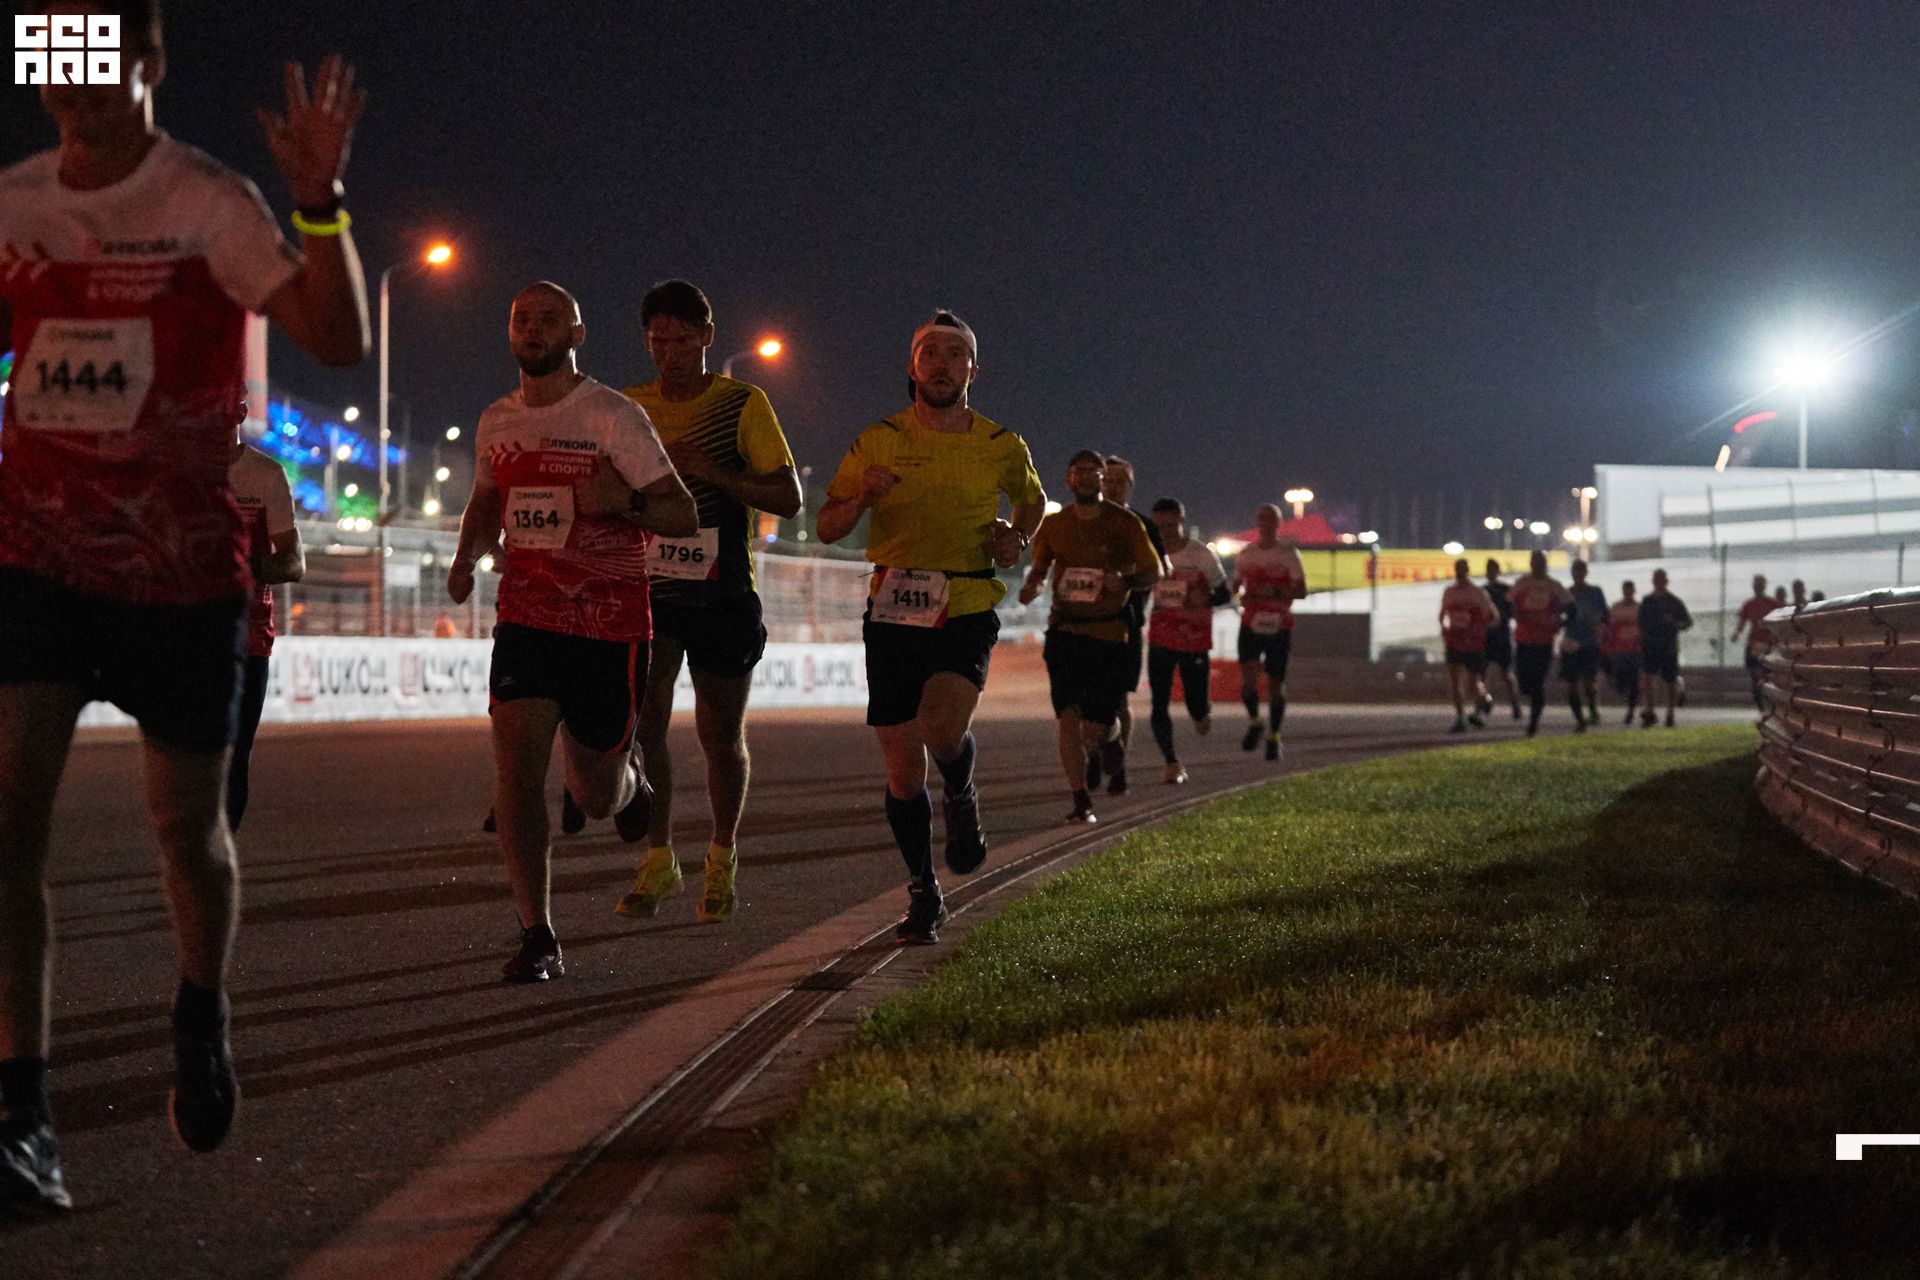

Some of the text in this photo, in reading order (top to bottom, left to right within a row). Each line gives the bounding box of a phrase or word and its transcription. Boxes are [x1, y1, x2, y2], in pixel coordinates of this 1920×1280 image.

[36, 359, 127, 394] 1444
[551, 438, 597, 451] ЛУКОЙЛ
[513, 510, 560, 528] 1364
[658, 544, 704, 563] 1796
[892, 588, 929, 607] 1411
